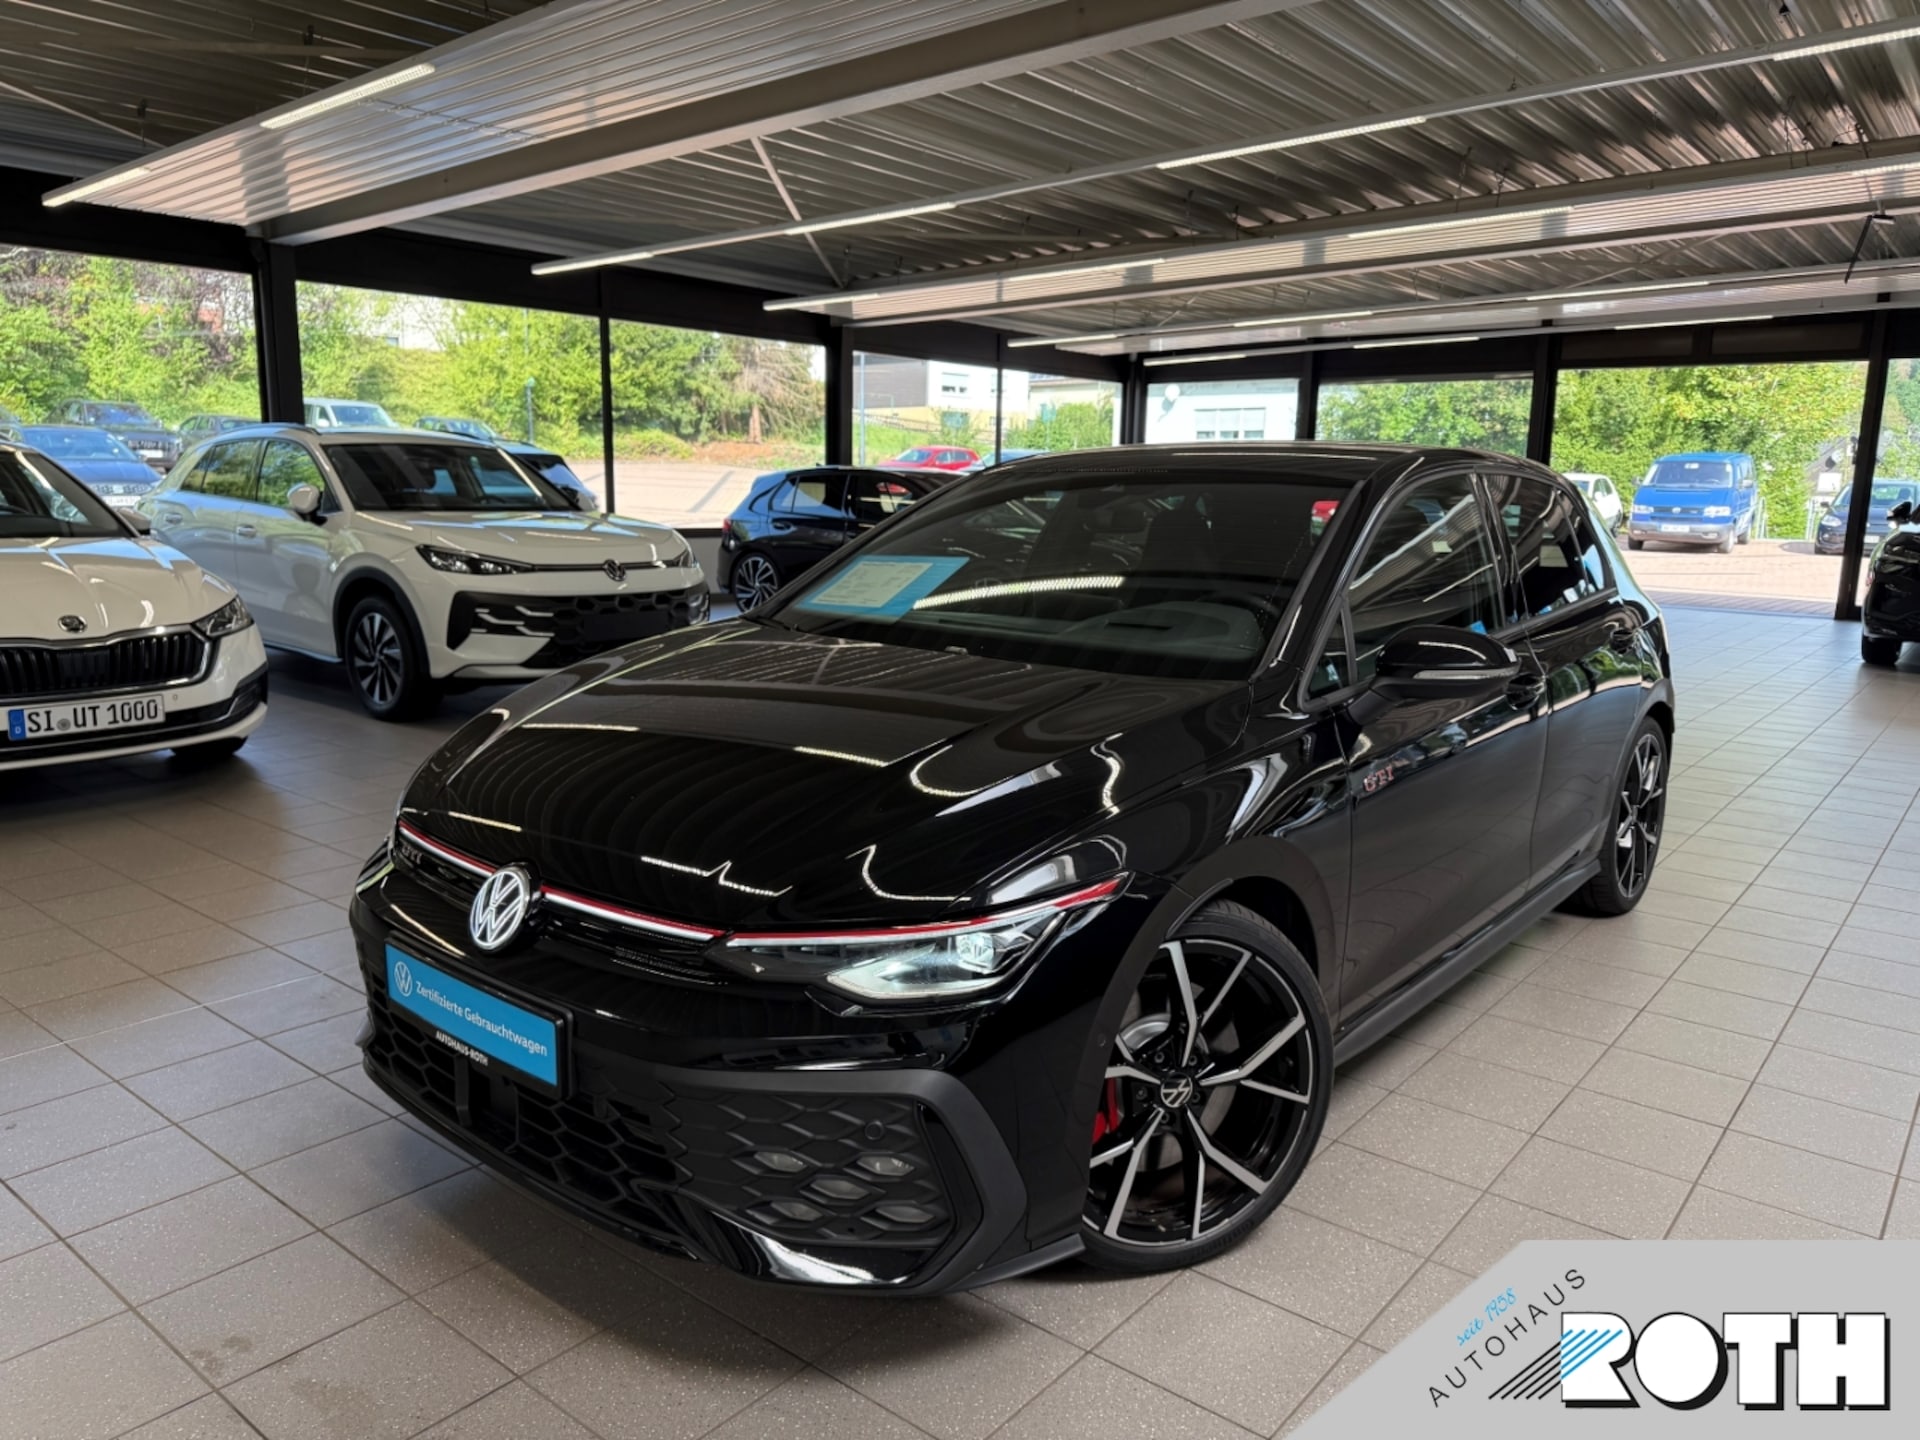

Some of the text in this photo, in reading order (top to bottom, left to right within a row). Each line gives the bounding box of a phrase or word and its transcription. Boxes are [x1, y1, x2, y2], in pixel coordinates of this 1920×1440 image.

[27, 710, 55, 733] SI
[73, 705, 100, 728] UT
[106, 699, 158, 725] 1000
[1363, 764, 1394, 792] GTI
[415, 980, 548, 1057] Zertifizierte Gebrauchtwagen
